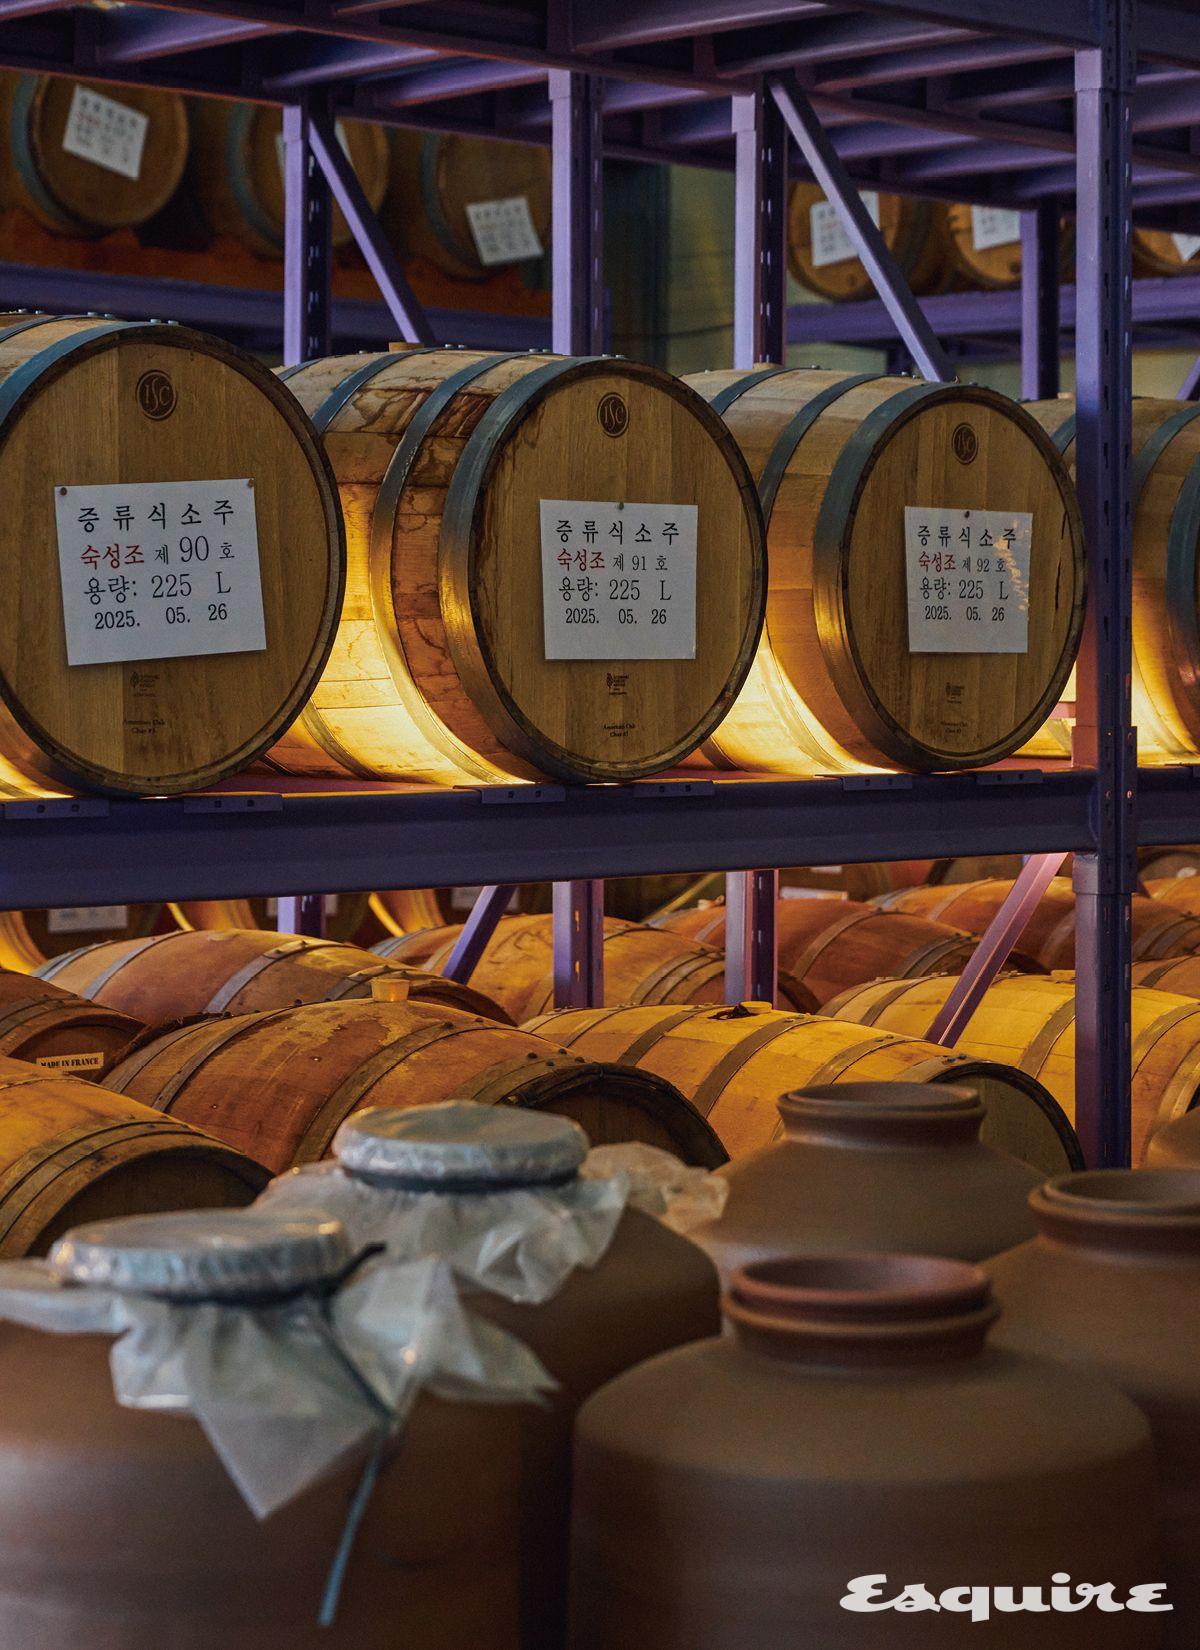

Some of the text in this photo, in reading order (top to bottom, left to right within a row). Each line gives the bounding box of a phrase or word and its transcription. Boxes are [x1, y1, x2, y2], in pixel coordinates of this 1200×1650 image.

[80, 535, 235, 570] 숙성조 제 90 호
[557, 548, 668, 572] 숙성조 제 91 호
[918, 551, 1007, 573] 숙성조 제 92 호
[83, 571, 232, 605] 용량: 225 L
[558, 576, 672, 602] 용량: 225 L
[920, 576, 1009, 600] 용량: 225 L
[94, 603, 228, 630] 2025. 05. 26
[565, 608, 667, 624] 2025. 05. 26
[925, 605, 1005, 621] 2025. 05. 26
[61, 1059, 70, 1067] IN
[71, 1057, 99, 1067] FRANCE
